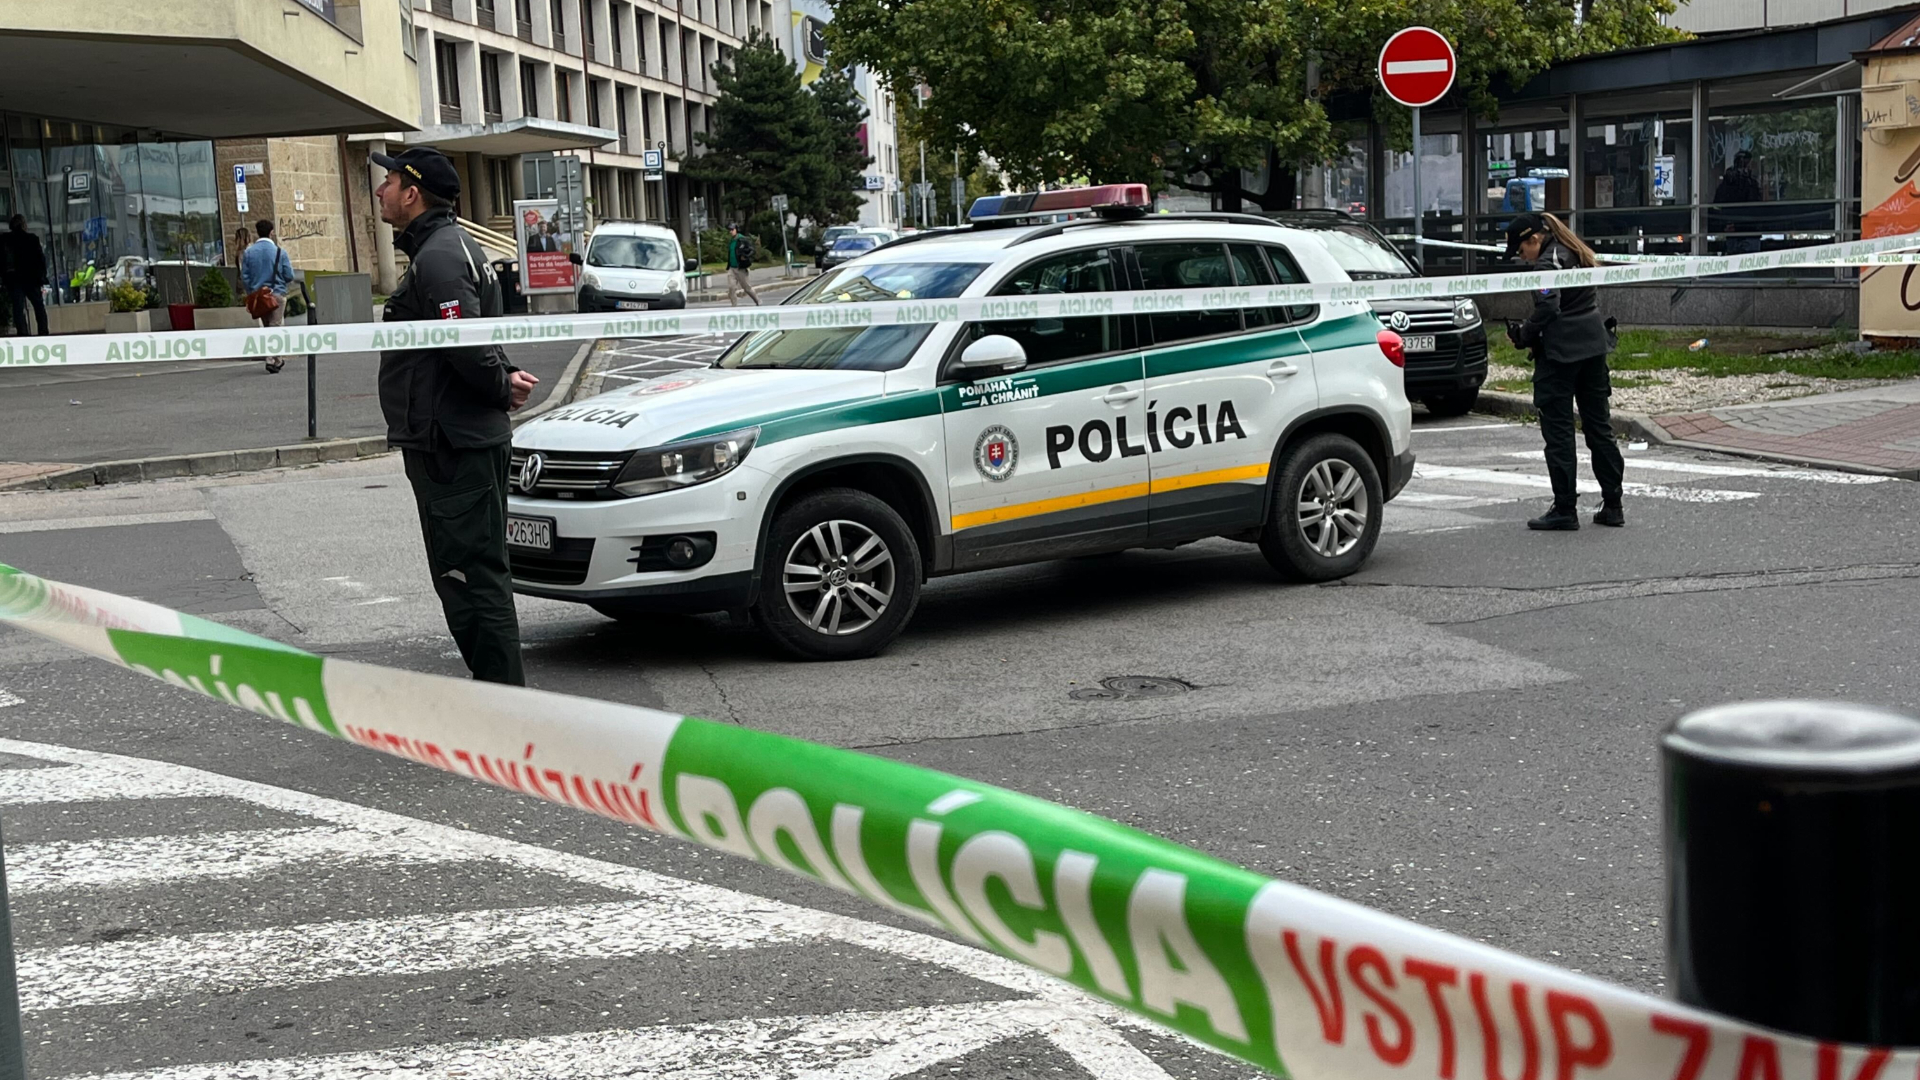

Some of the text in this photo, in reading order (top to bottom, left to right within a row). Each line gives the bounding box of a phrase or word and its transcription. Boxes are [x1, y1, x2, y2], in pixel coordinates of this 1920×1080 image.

[958, 377, 1014, 398] POMÁHAŤ
[980, 384, 1039, 407] A CHRÁNIŤ
[1046, 399, 1247, 470] POLÍCIA
[513, 521, 549, 547] 263HC
[676, 773, 1250, 1044] POLÍCIA
[1281, 929, 1614, 1080] VSTUP
